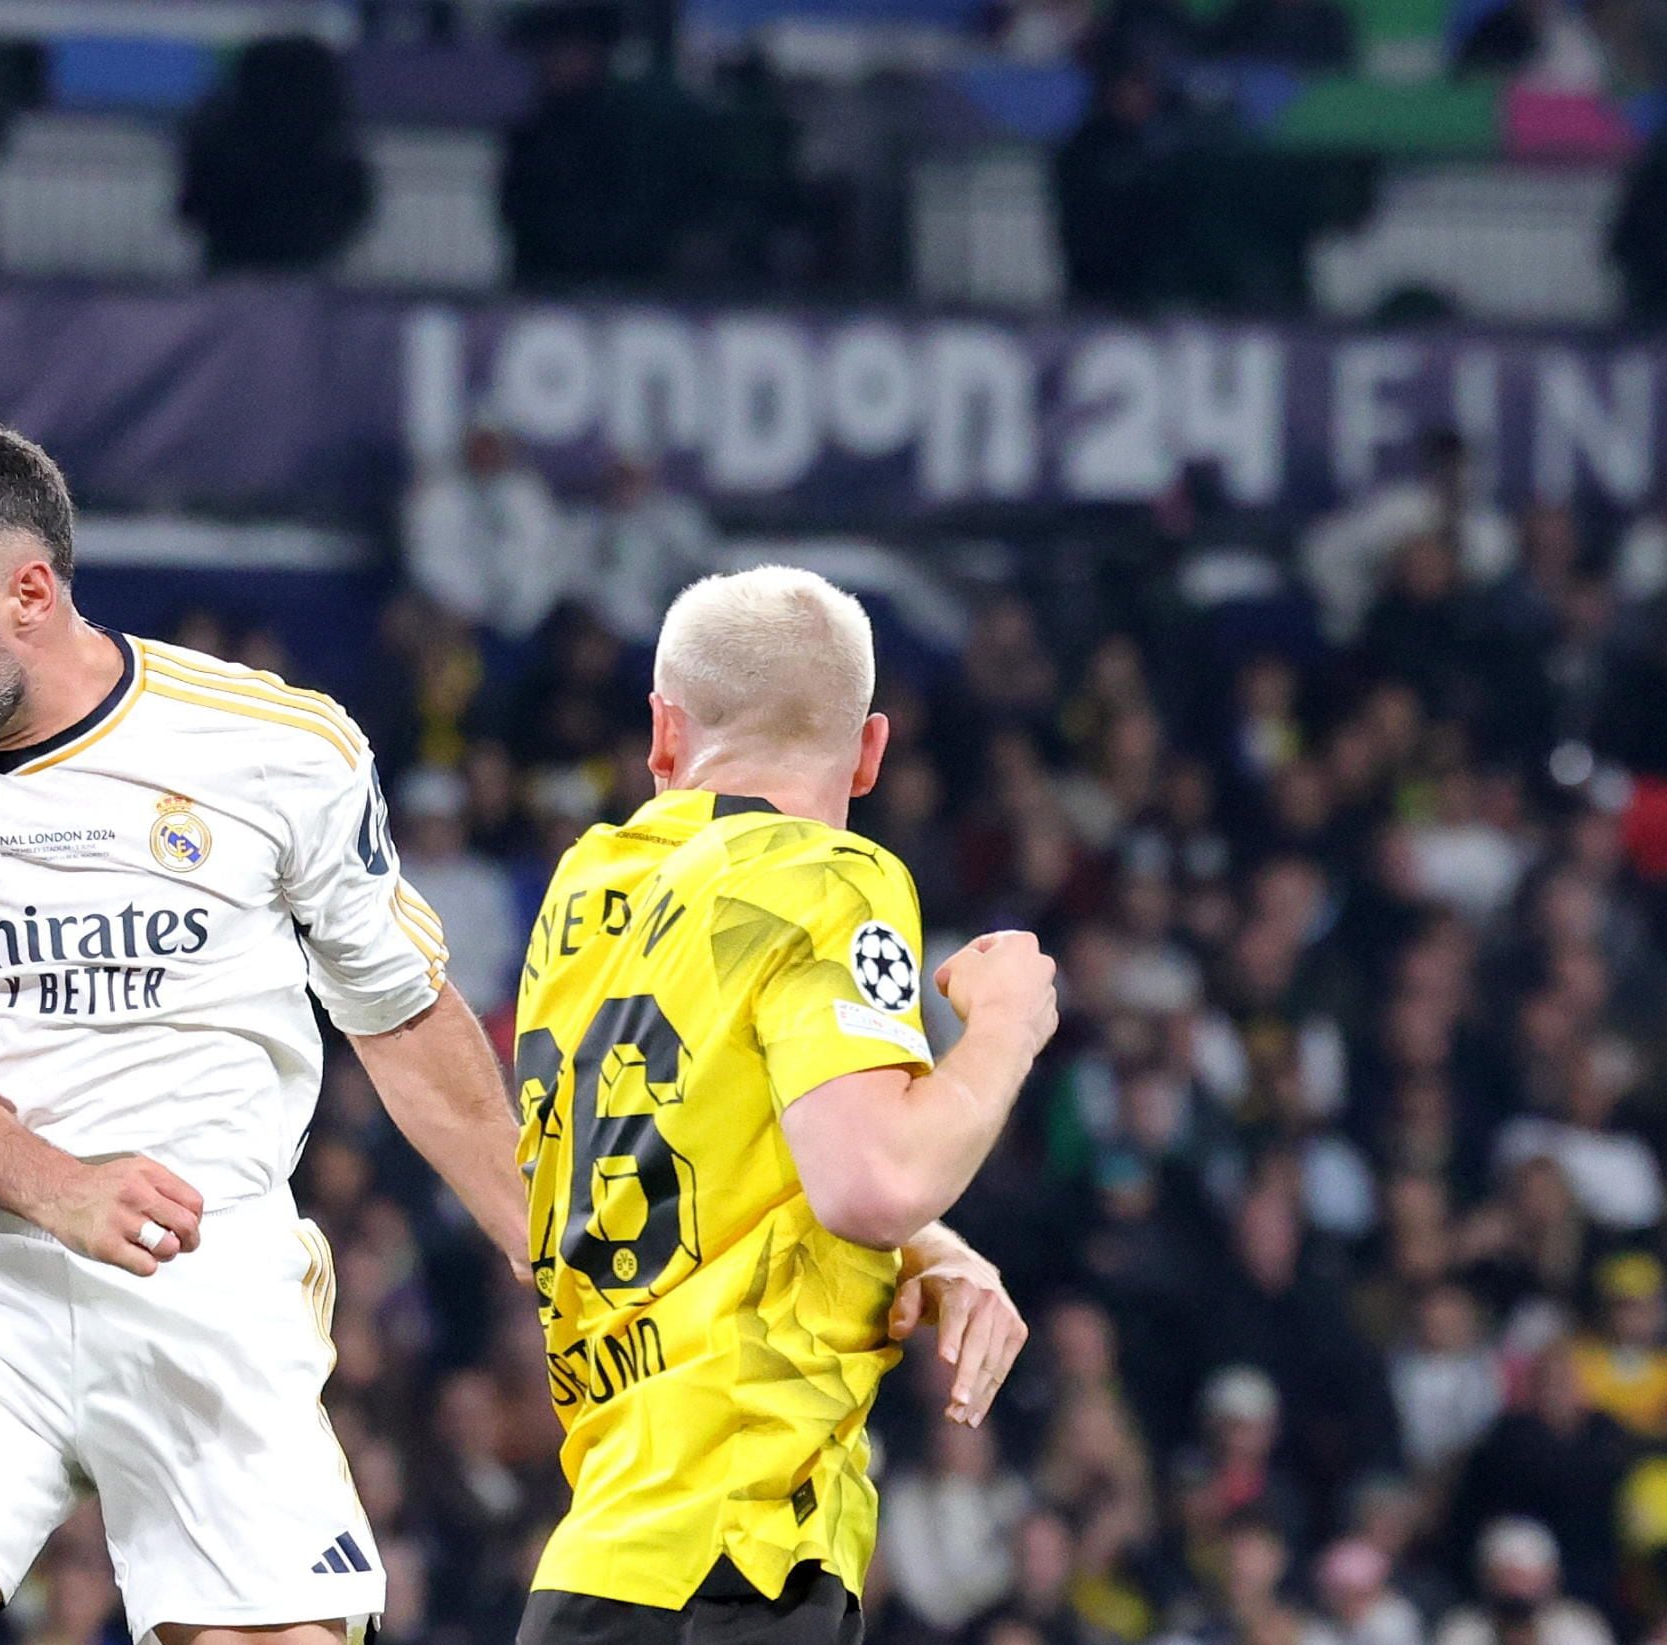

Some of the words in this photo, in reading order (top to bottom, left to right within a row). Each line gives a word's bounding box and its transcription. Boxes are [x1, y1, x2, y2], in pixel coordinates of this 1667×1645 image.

[1063, 320, 1285, 503] 24
[29, 831, 82, 845] LONDON
[86, 829, 115, 840] 2024
[39, 966, 167, 1016] BETTER
